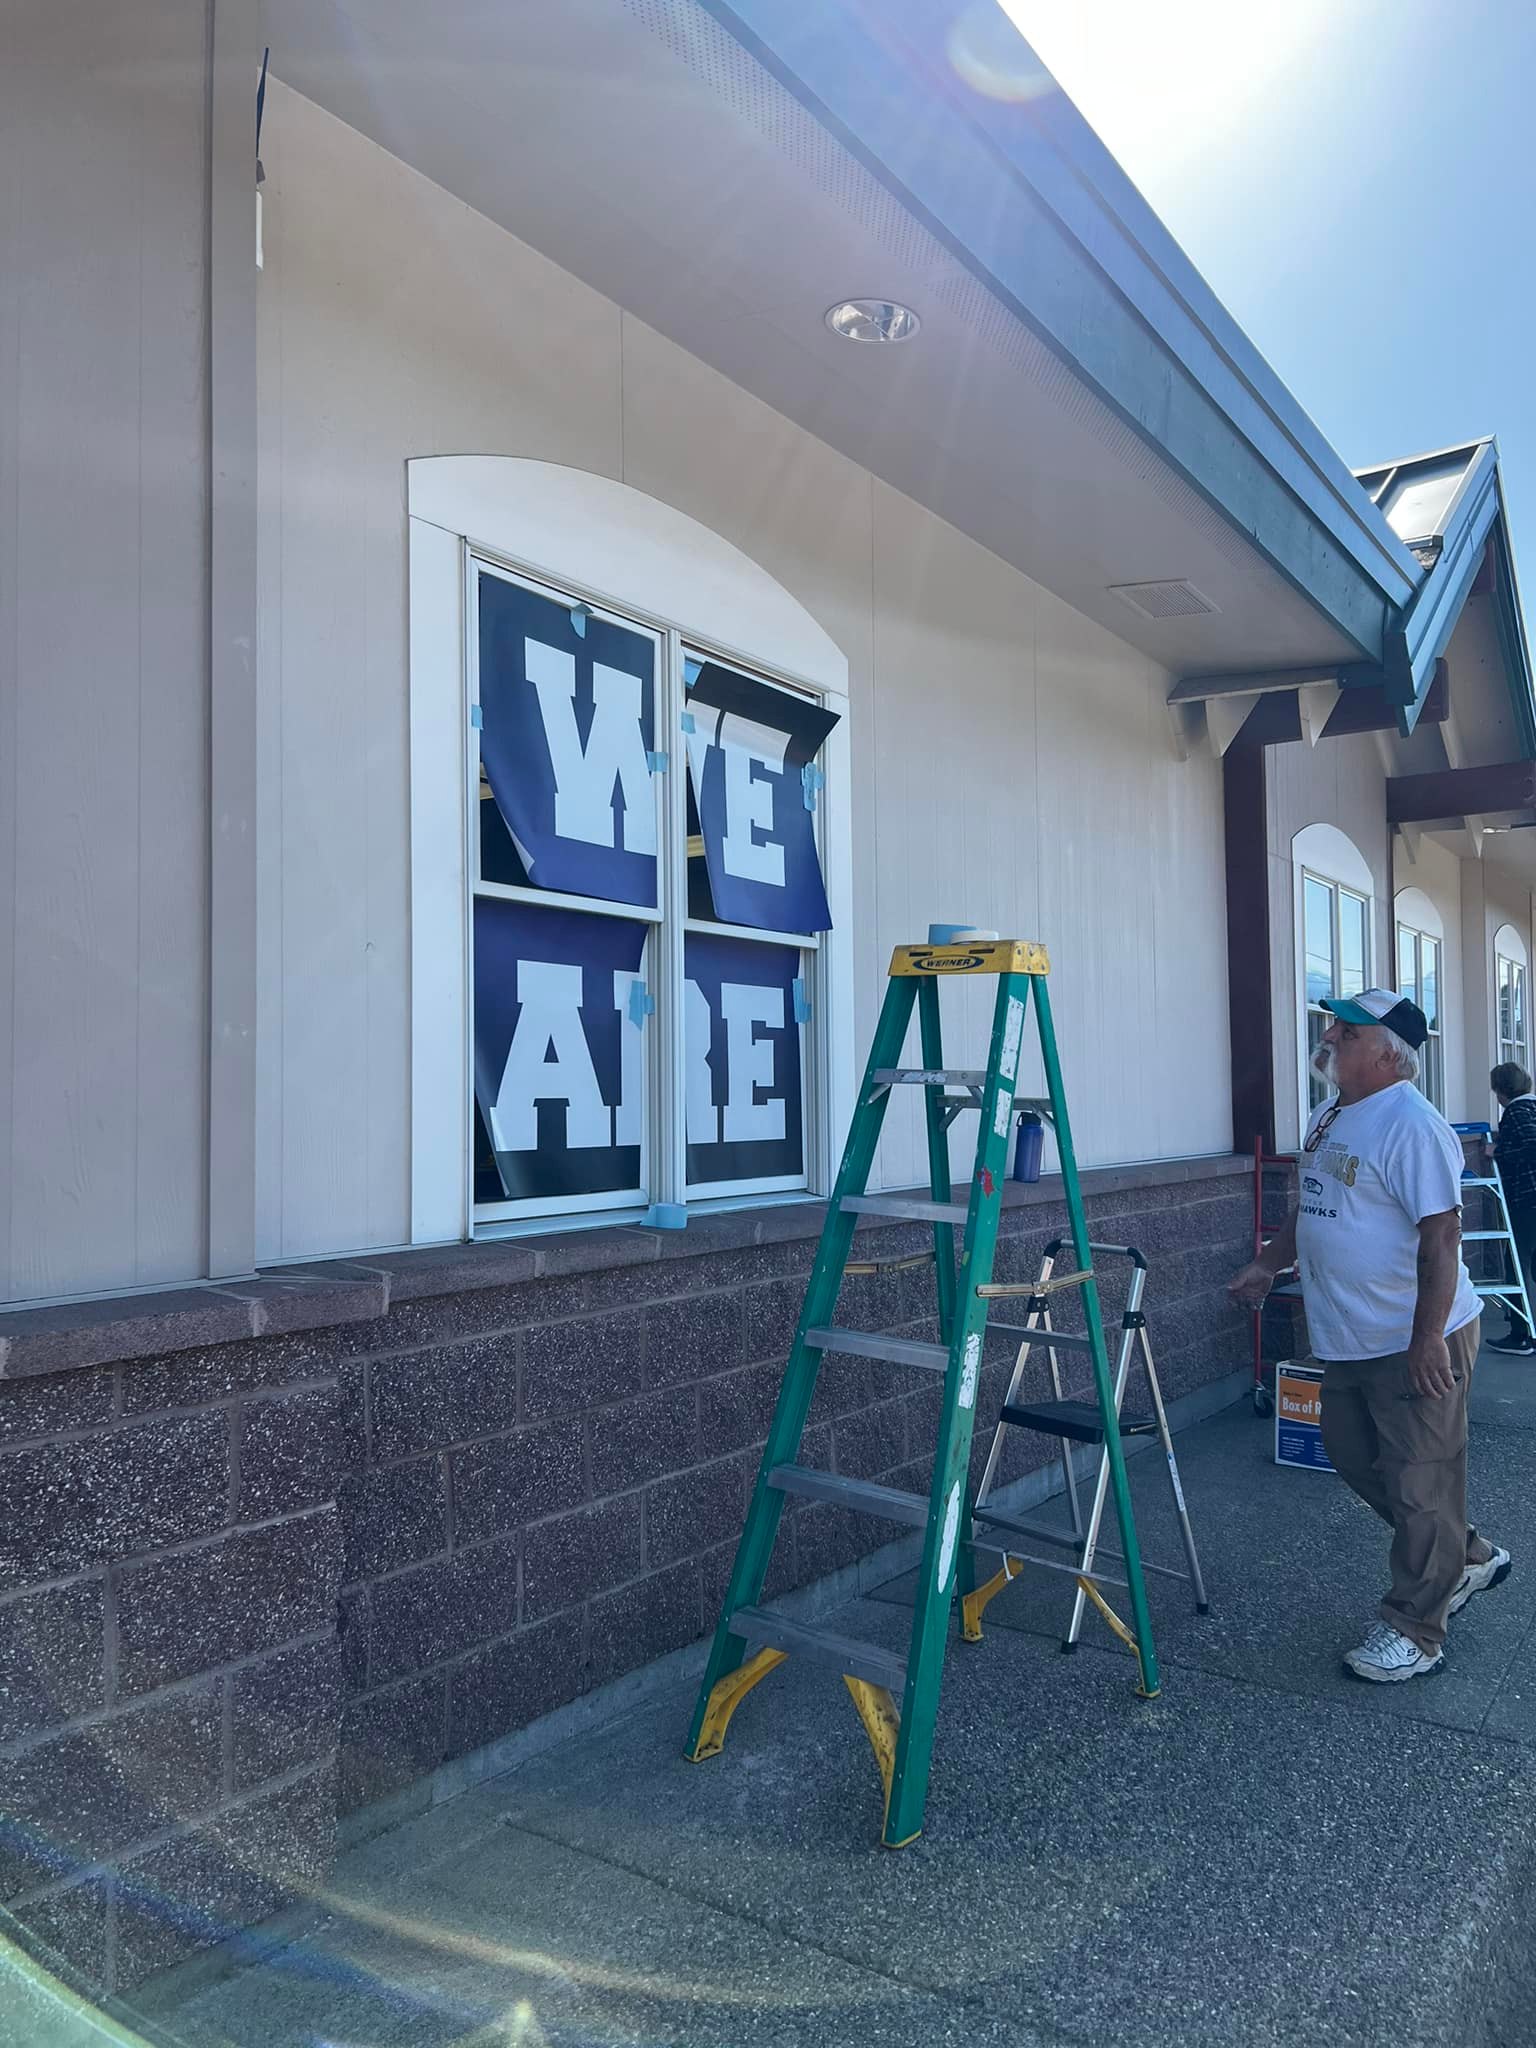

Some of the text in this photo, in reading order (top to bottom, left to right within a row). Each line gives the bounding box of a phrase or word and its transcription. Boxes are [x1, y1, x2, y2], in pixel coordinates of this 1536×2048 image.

[524, 636, 793, 888] WE
[927, 959, 970, 967] WERNER
[490, 959, 787, 1152] ARE
[1282, 1397, 1301, 1413] Box
[1302, 1399, 1312, 1414] of
